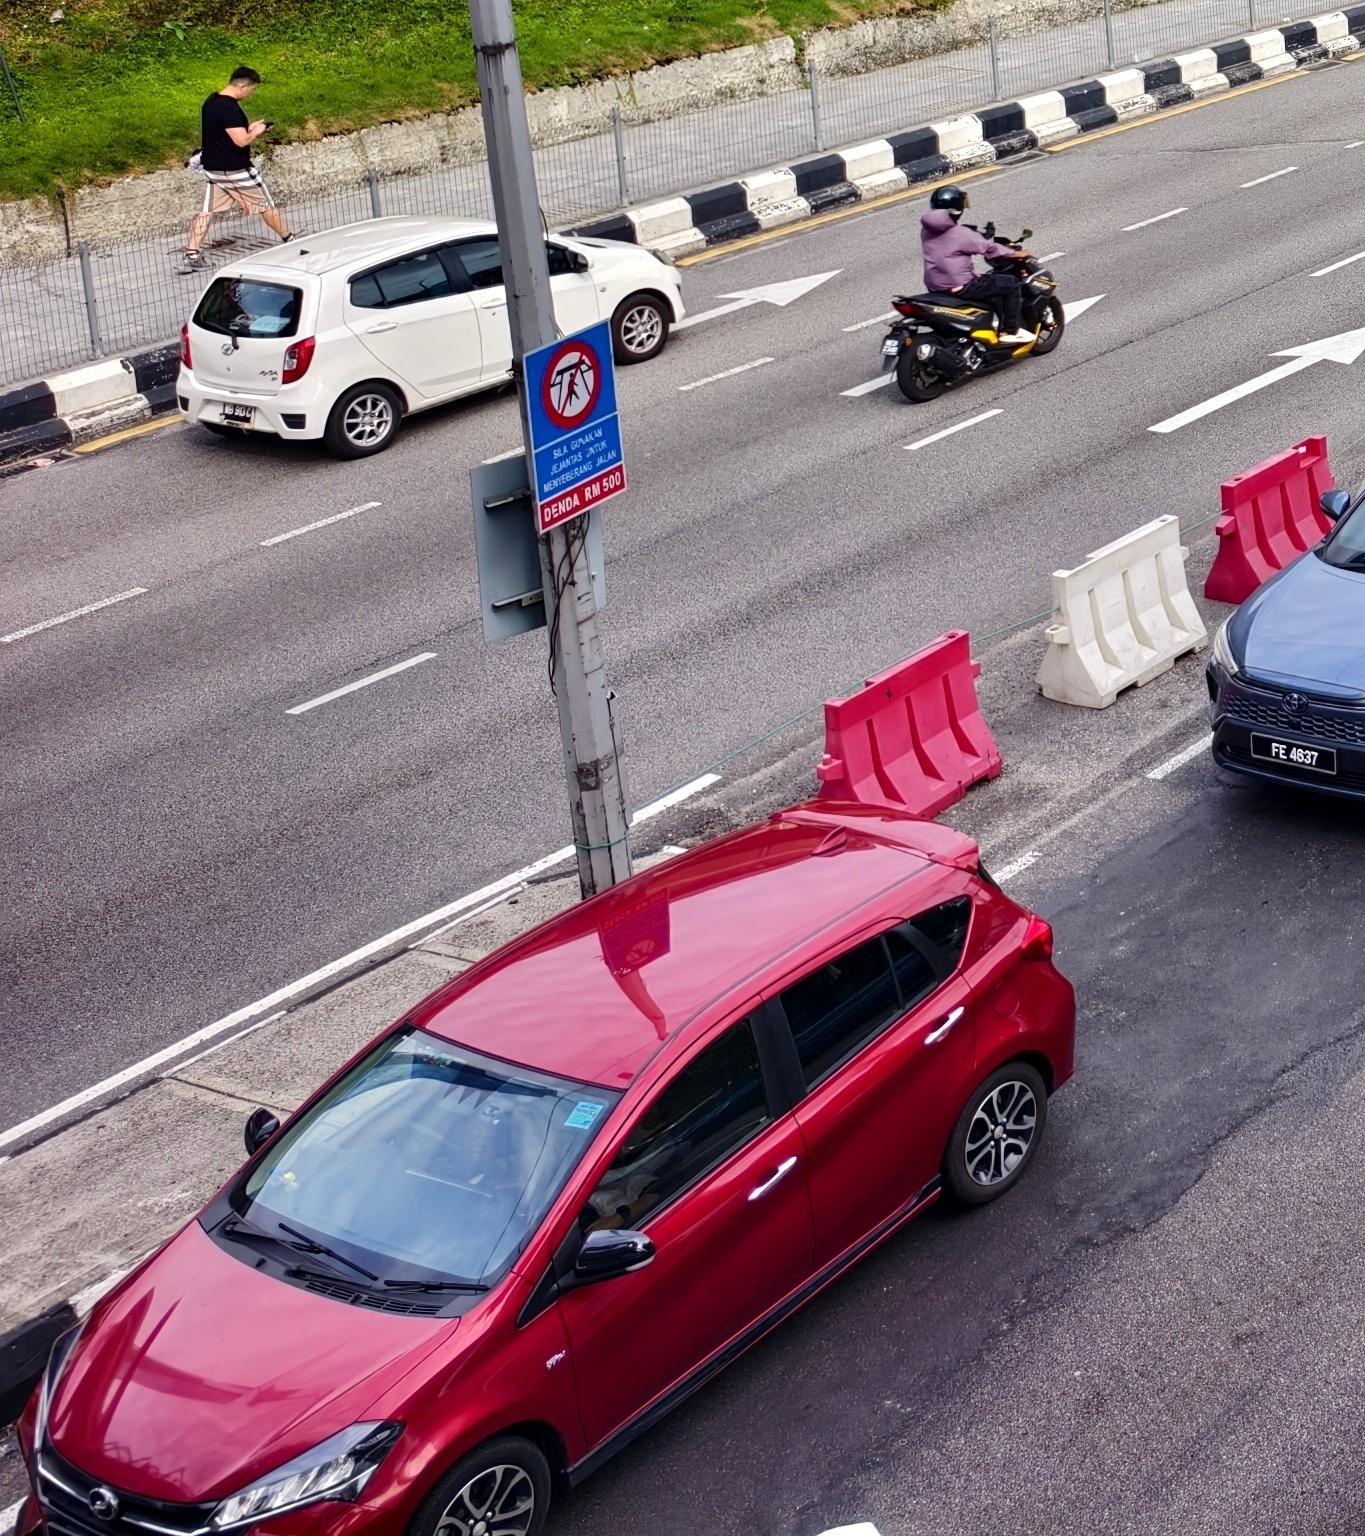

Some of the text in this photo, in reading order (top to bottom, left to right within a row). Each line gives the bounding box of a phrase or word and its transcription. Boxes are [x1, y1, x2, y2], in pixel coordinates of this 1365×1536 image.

[551, 452, 583, 476] JEJANTAS
[552, 444, 568, 460] SILA
[543, 449, 617, 493] MENYEBERANG JALAN
[543, 471, 622, 523] DENDA RM 500
[1271, 742, 1319, 766] FE 4637
